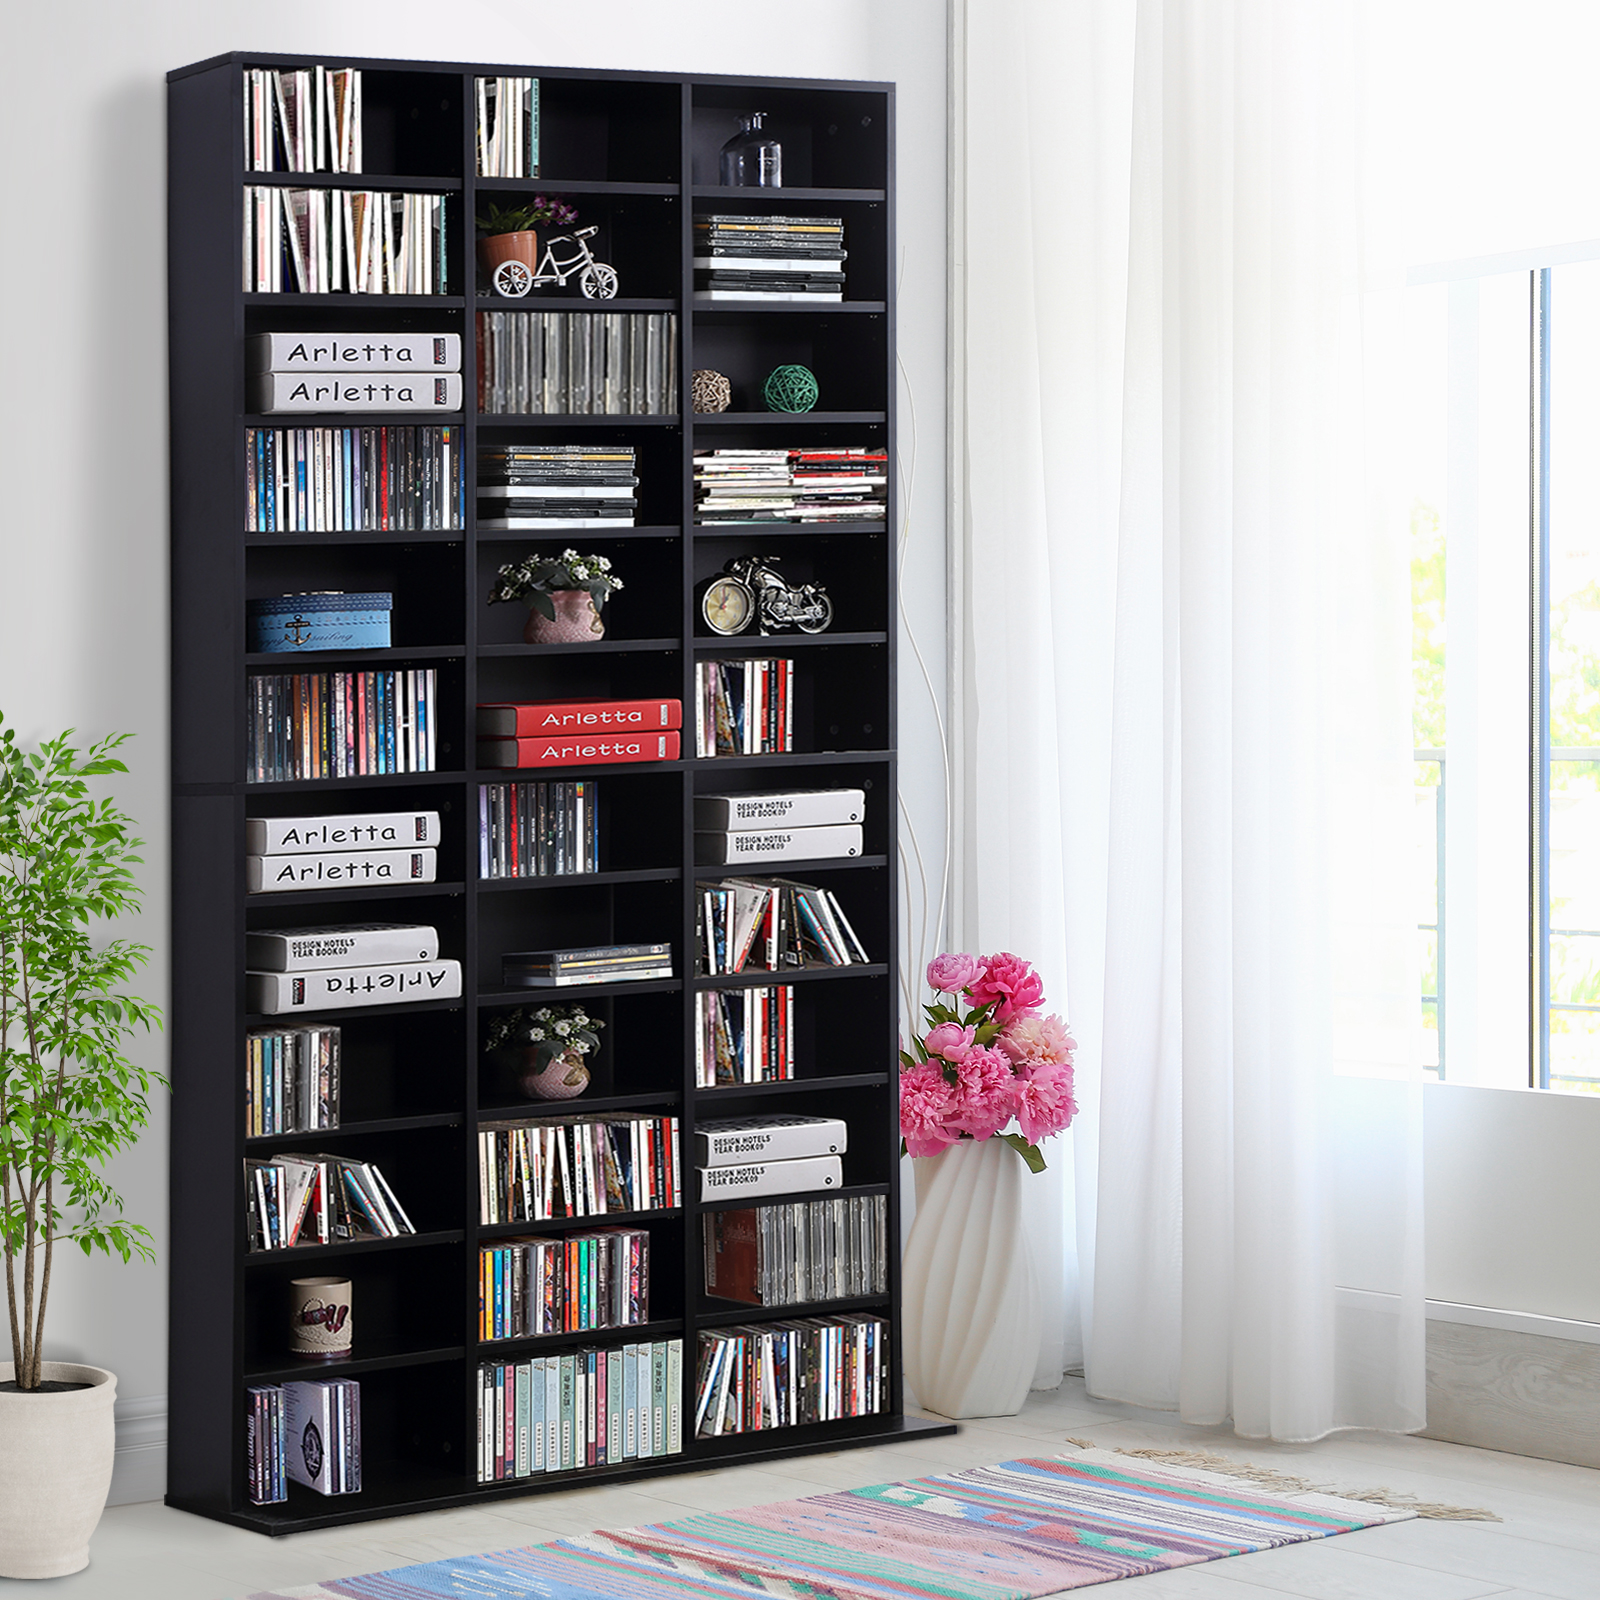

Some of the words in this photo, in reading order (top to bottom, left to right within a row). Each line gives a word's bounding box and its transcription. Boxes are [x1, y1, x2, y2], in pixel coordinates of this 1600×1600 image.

[288, 341, 413, 362] Arletta
[289, 381, 414, 402] Arletta
[542, 710, 642, 726] Arletta
[541, 743, 641, 759] Arletta
[737, 802, 763, 811] DESIGN
[765, 801, 793, 809] HOTELS
[737, 810, 756, 819] YEAR
[282, 825, 396, 845] Arletta
[735, 836, 762, 845] DESIGN
[764, 835, 792, 843] HOTELS
[735, 844, 755, 852] YEAR
[277, 861, 392, 882] Arletta
[292, 941, 321, 950] DESIGN
[324, 939, 355, 947] HOTELS
[292, 949, 313, 958] YEAR
[326, 970, 447, 994] Arletta
[714, 1137, 740, 1147] DESIGN
[714, 1146, 735, 1155] YEAR
[708, 1169, 734, 1179] DESIGN
[708, 1179, 727, 1187] YEAR
